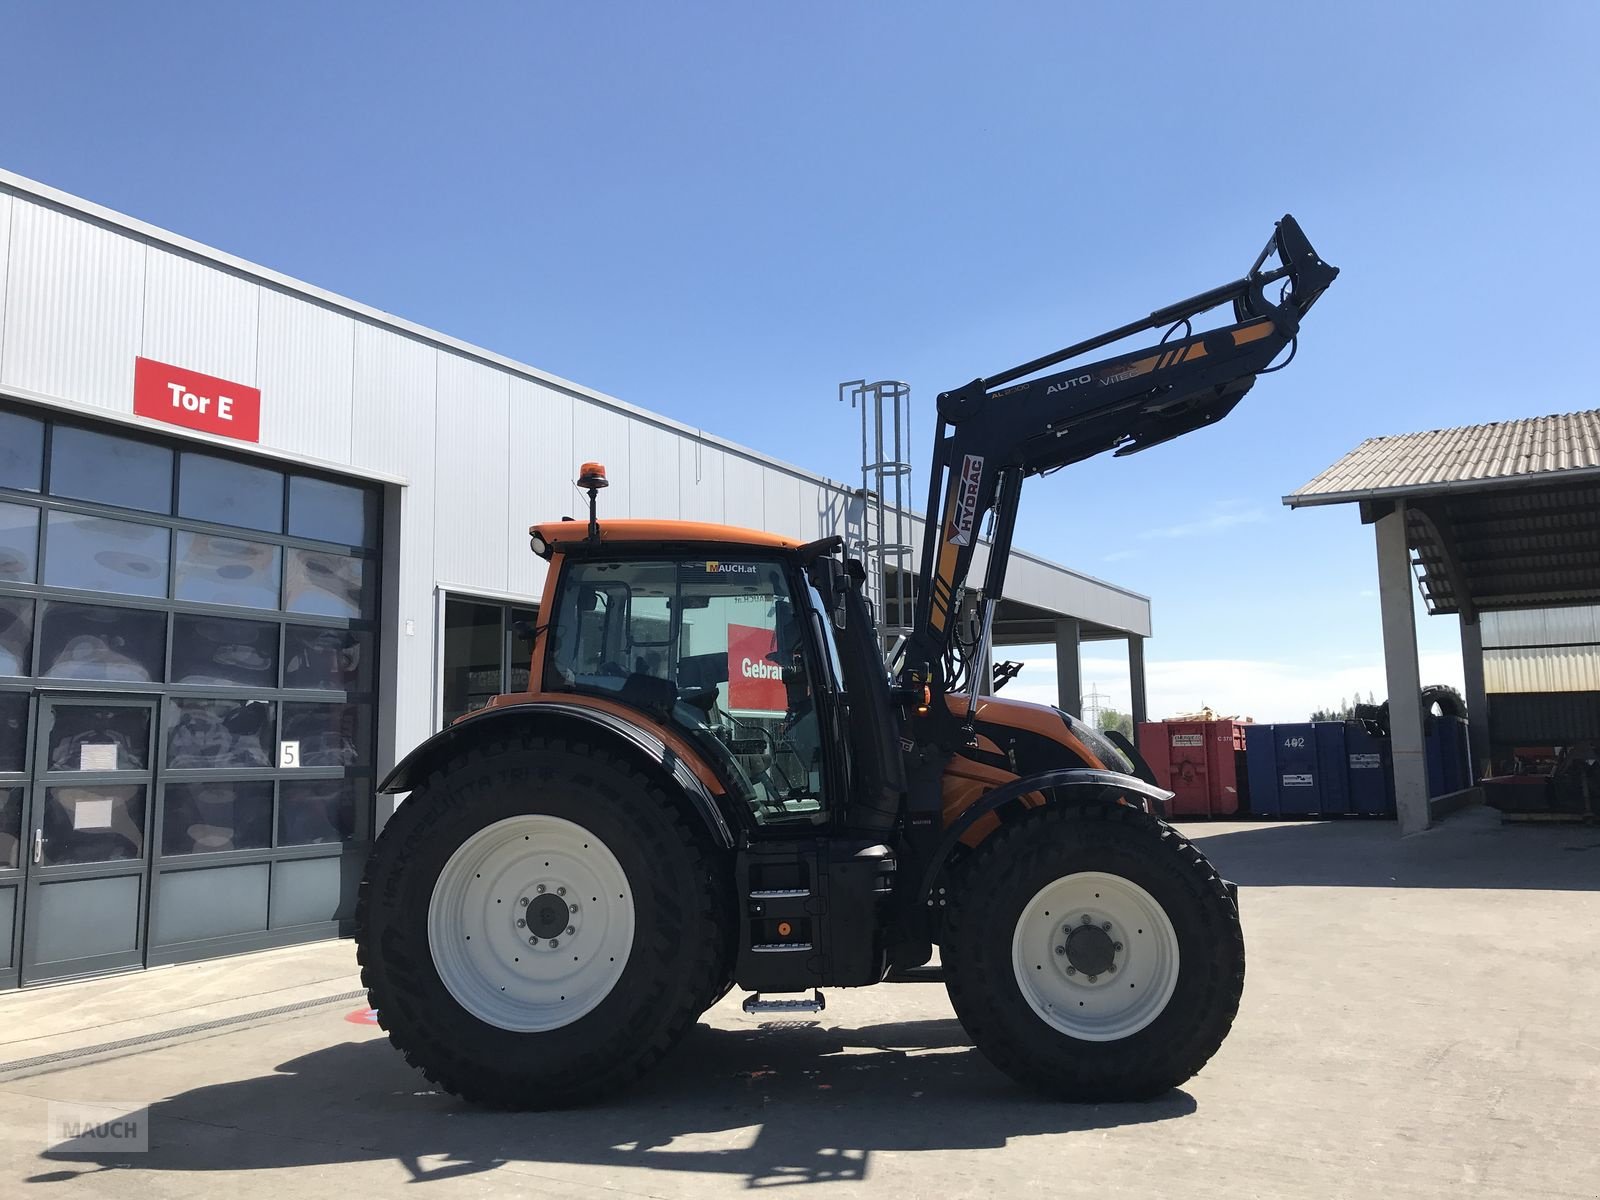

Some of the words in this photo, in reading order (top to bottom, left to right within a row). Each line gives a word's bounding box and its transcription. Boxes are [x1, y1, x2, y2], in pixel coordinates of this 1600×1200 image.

[1046, 374, 1092, 395] AUTO
[167, 382, 211, 414] Tor
[217, 395, 234, 421] E
[991, 391, 1004, 400] AL
[960, 460, 982, 532] HYDRAC
[709, 563, 757, 573] MAUCH.at
[284, 745, 294, 764] 5
